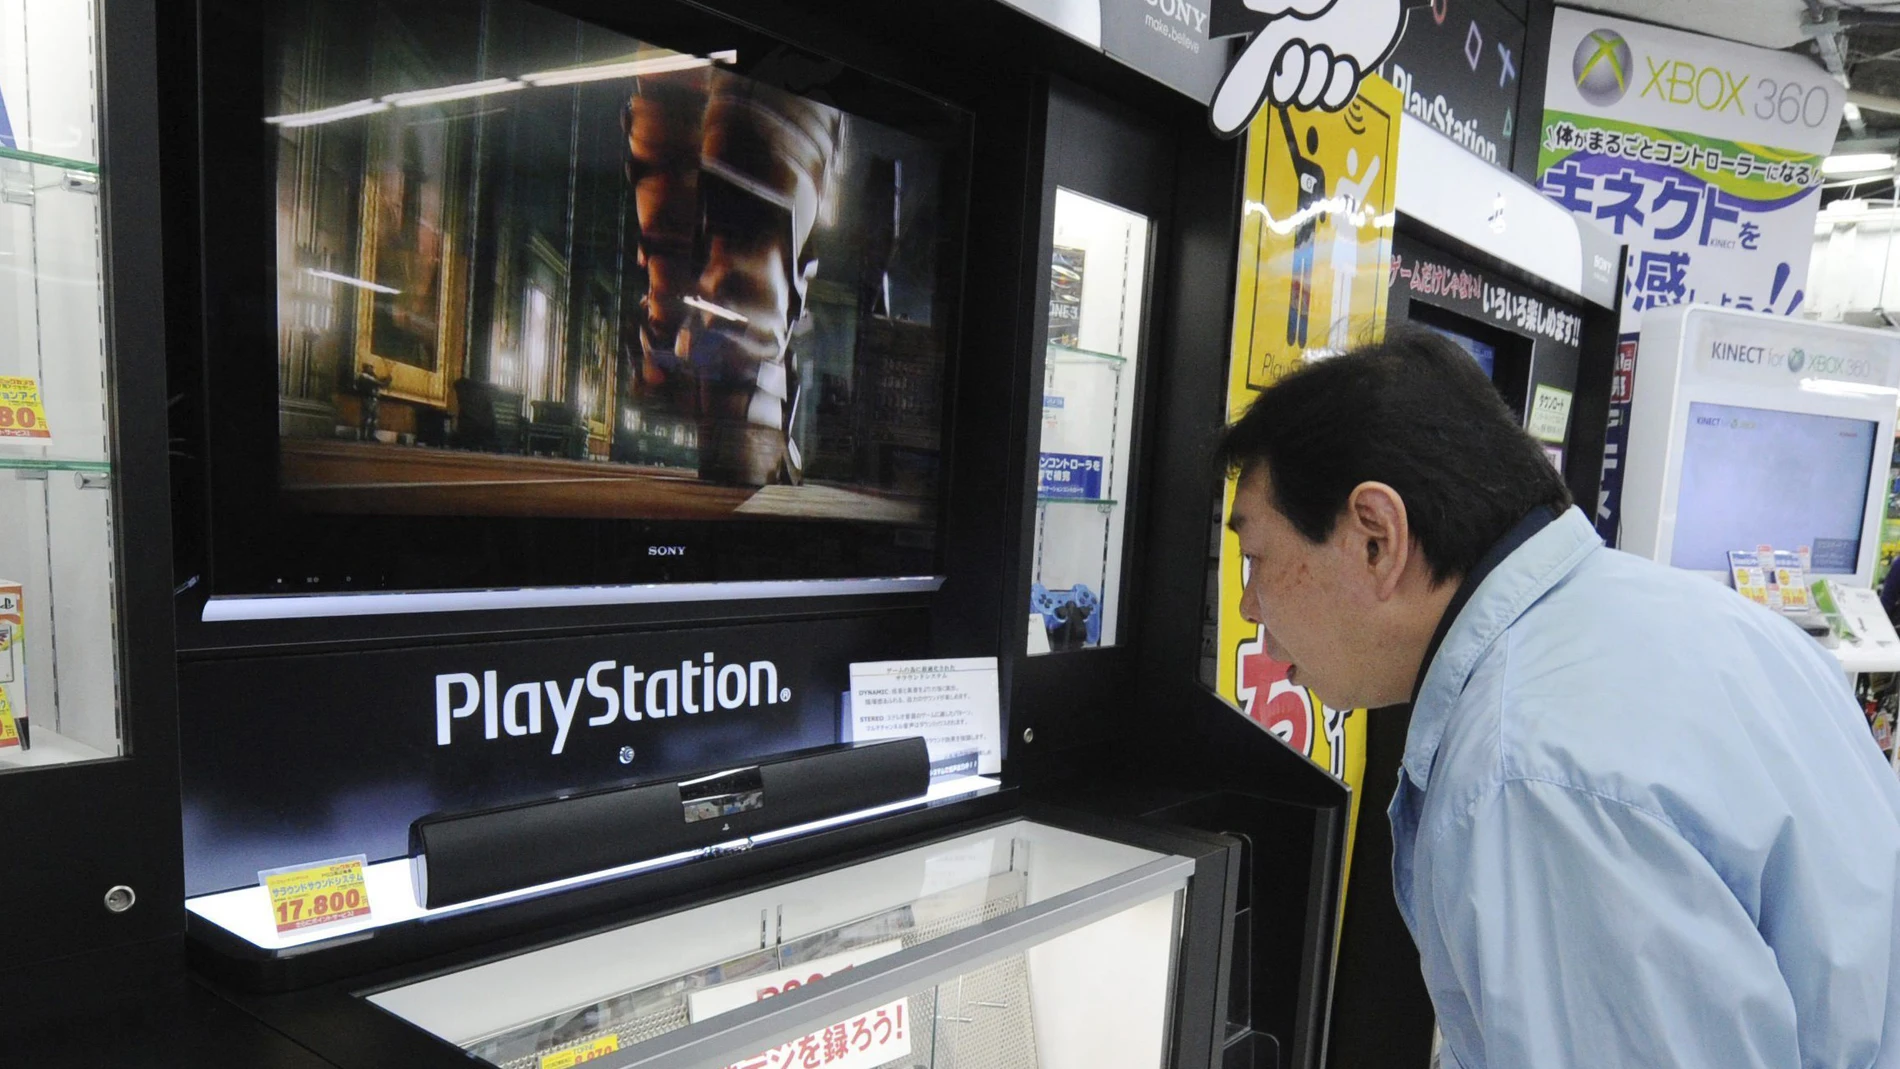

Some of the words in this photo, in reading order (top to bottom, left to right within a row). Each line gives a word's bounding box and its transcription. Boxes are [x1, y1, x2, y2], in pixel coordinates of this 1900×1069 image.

[1145, 0, 1207, 33] ONY
[1641, 55, 1750, 116] XBOX
[1753, 77, 1830, 128] 360
[1709, 238, 1736, 250] KINECT
[1711, 342, 1764, 365] KINECT
[1807, 353, 1846, 375] XBOX
[648, 546, 686, 556] SONY
[859, 715, 885, 723] STEREO
[276, 888, 360, 923] 17,800
